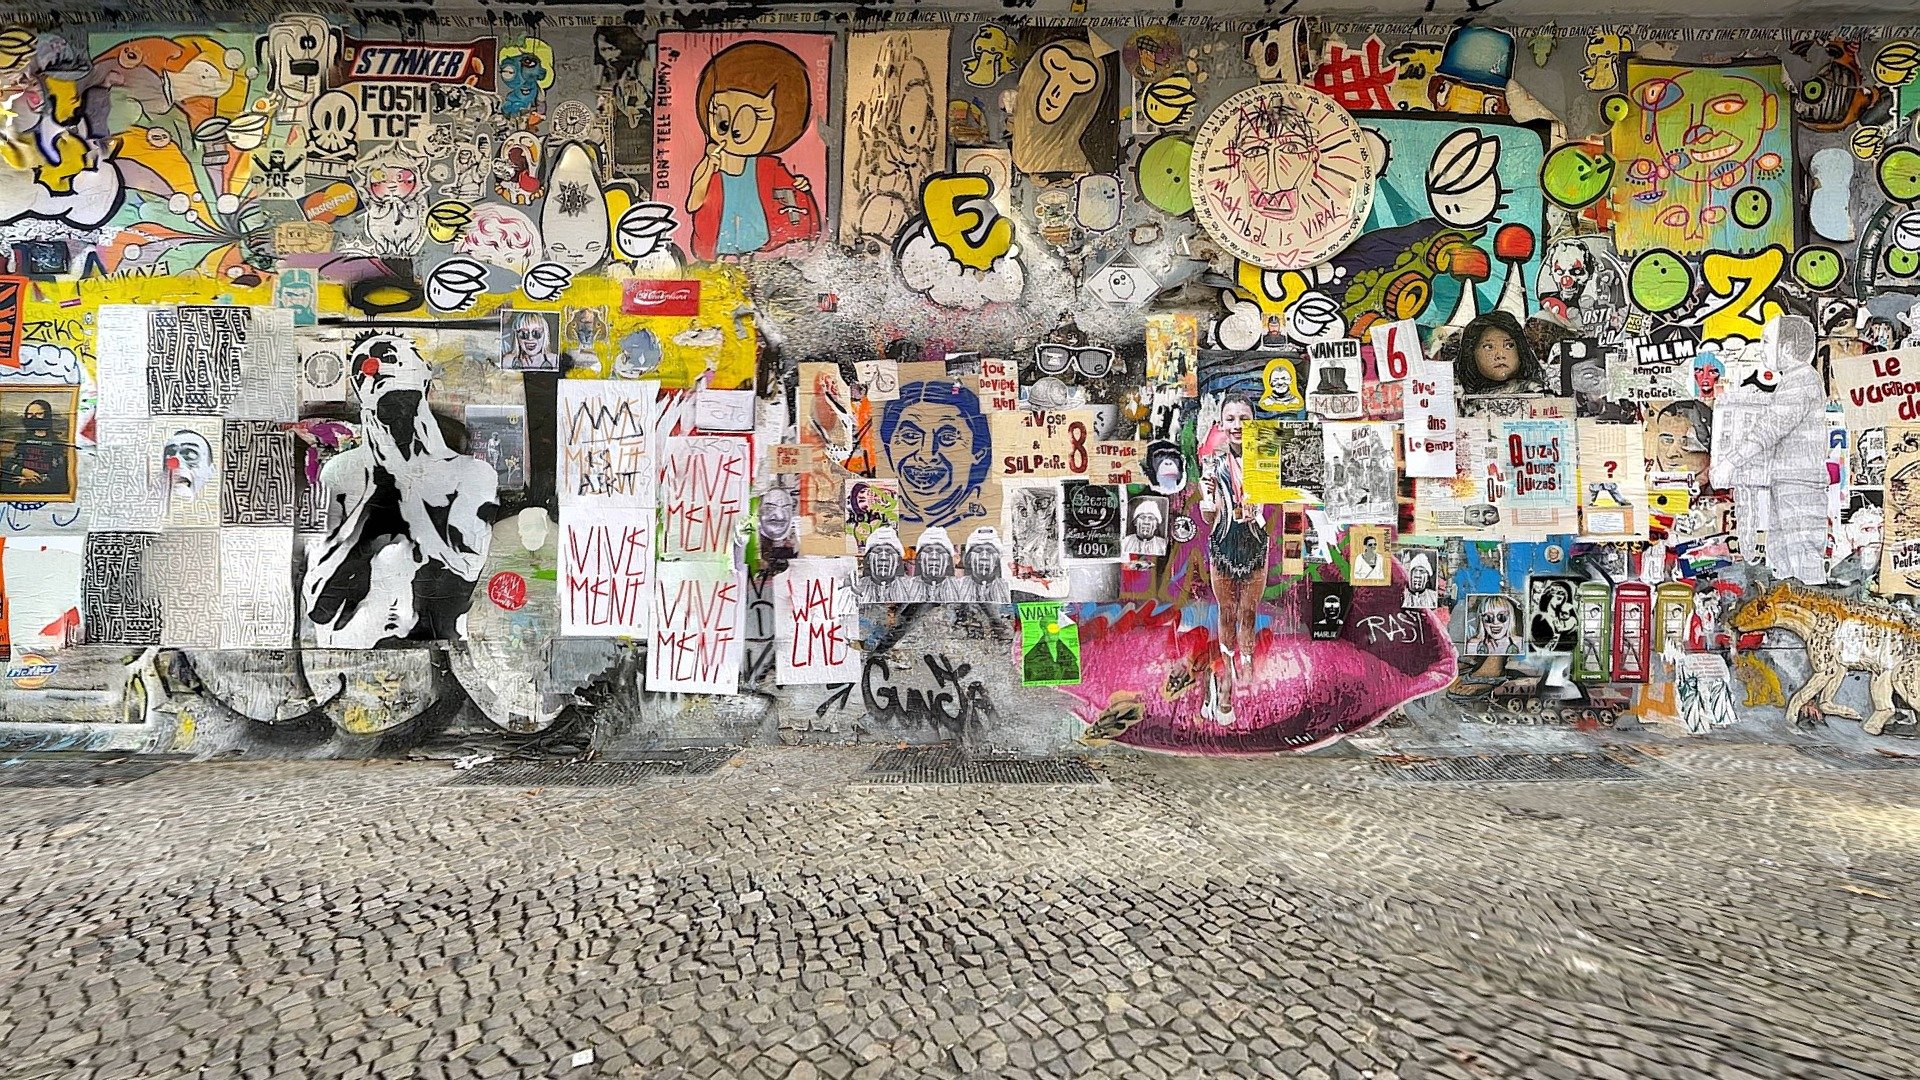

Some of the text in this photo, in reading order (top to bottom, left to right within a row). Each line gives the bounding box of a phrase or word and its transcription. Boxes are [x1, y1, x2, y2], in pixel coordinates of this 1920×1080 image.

[575, 16, 597, 27] TIME
[777, 13, 799, 23] TIME
[1064, 17, 1086, 27] TIME
[1100, 17, 1131, 27] DANCE
[1350, 23, 1372, 33] TIME
[1384, 23, 1415, 34] DANCE
[1569, 26, 1598, 37] DANCE
[1649, 29, 1679, 40] DANCE
[1714, 29, 1737, 39] TIME
[1750, 29, 1780, 39] DANCE
[368, 114, 422, 138] TCF
[1310, 340, 1358, 360] WANTED
[1386, 326, 1409, 380] 6
[1639, 340, 1696, 364] MLM
[1898, 394, 1920, 421] d
[1067, 421, 1089, 474] 8
[1077, 542, 1108, 556] 1090
[1020, 605, 1062, 621] WANT
